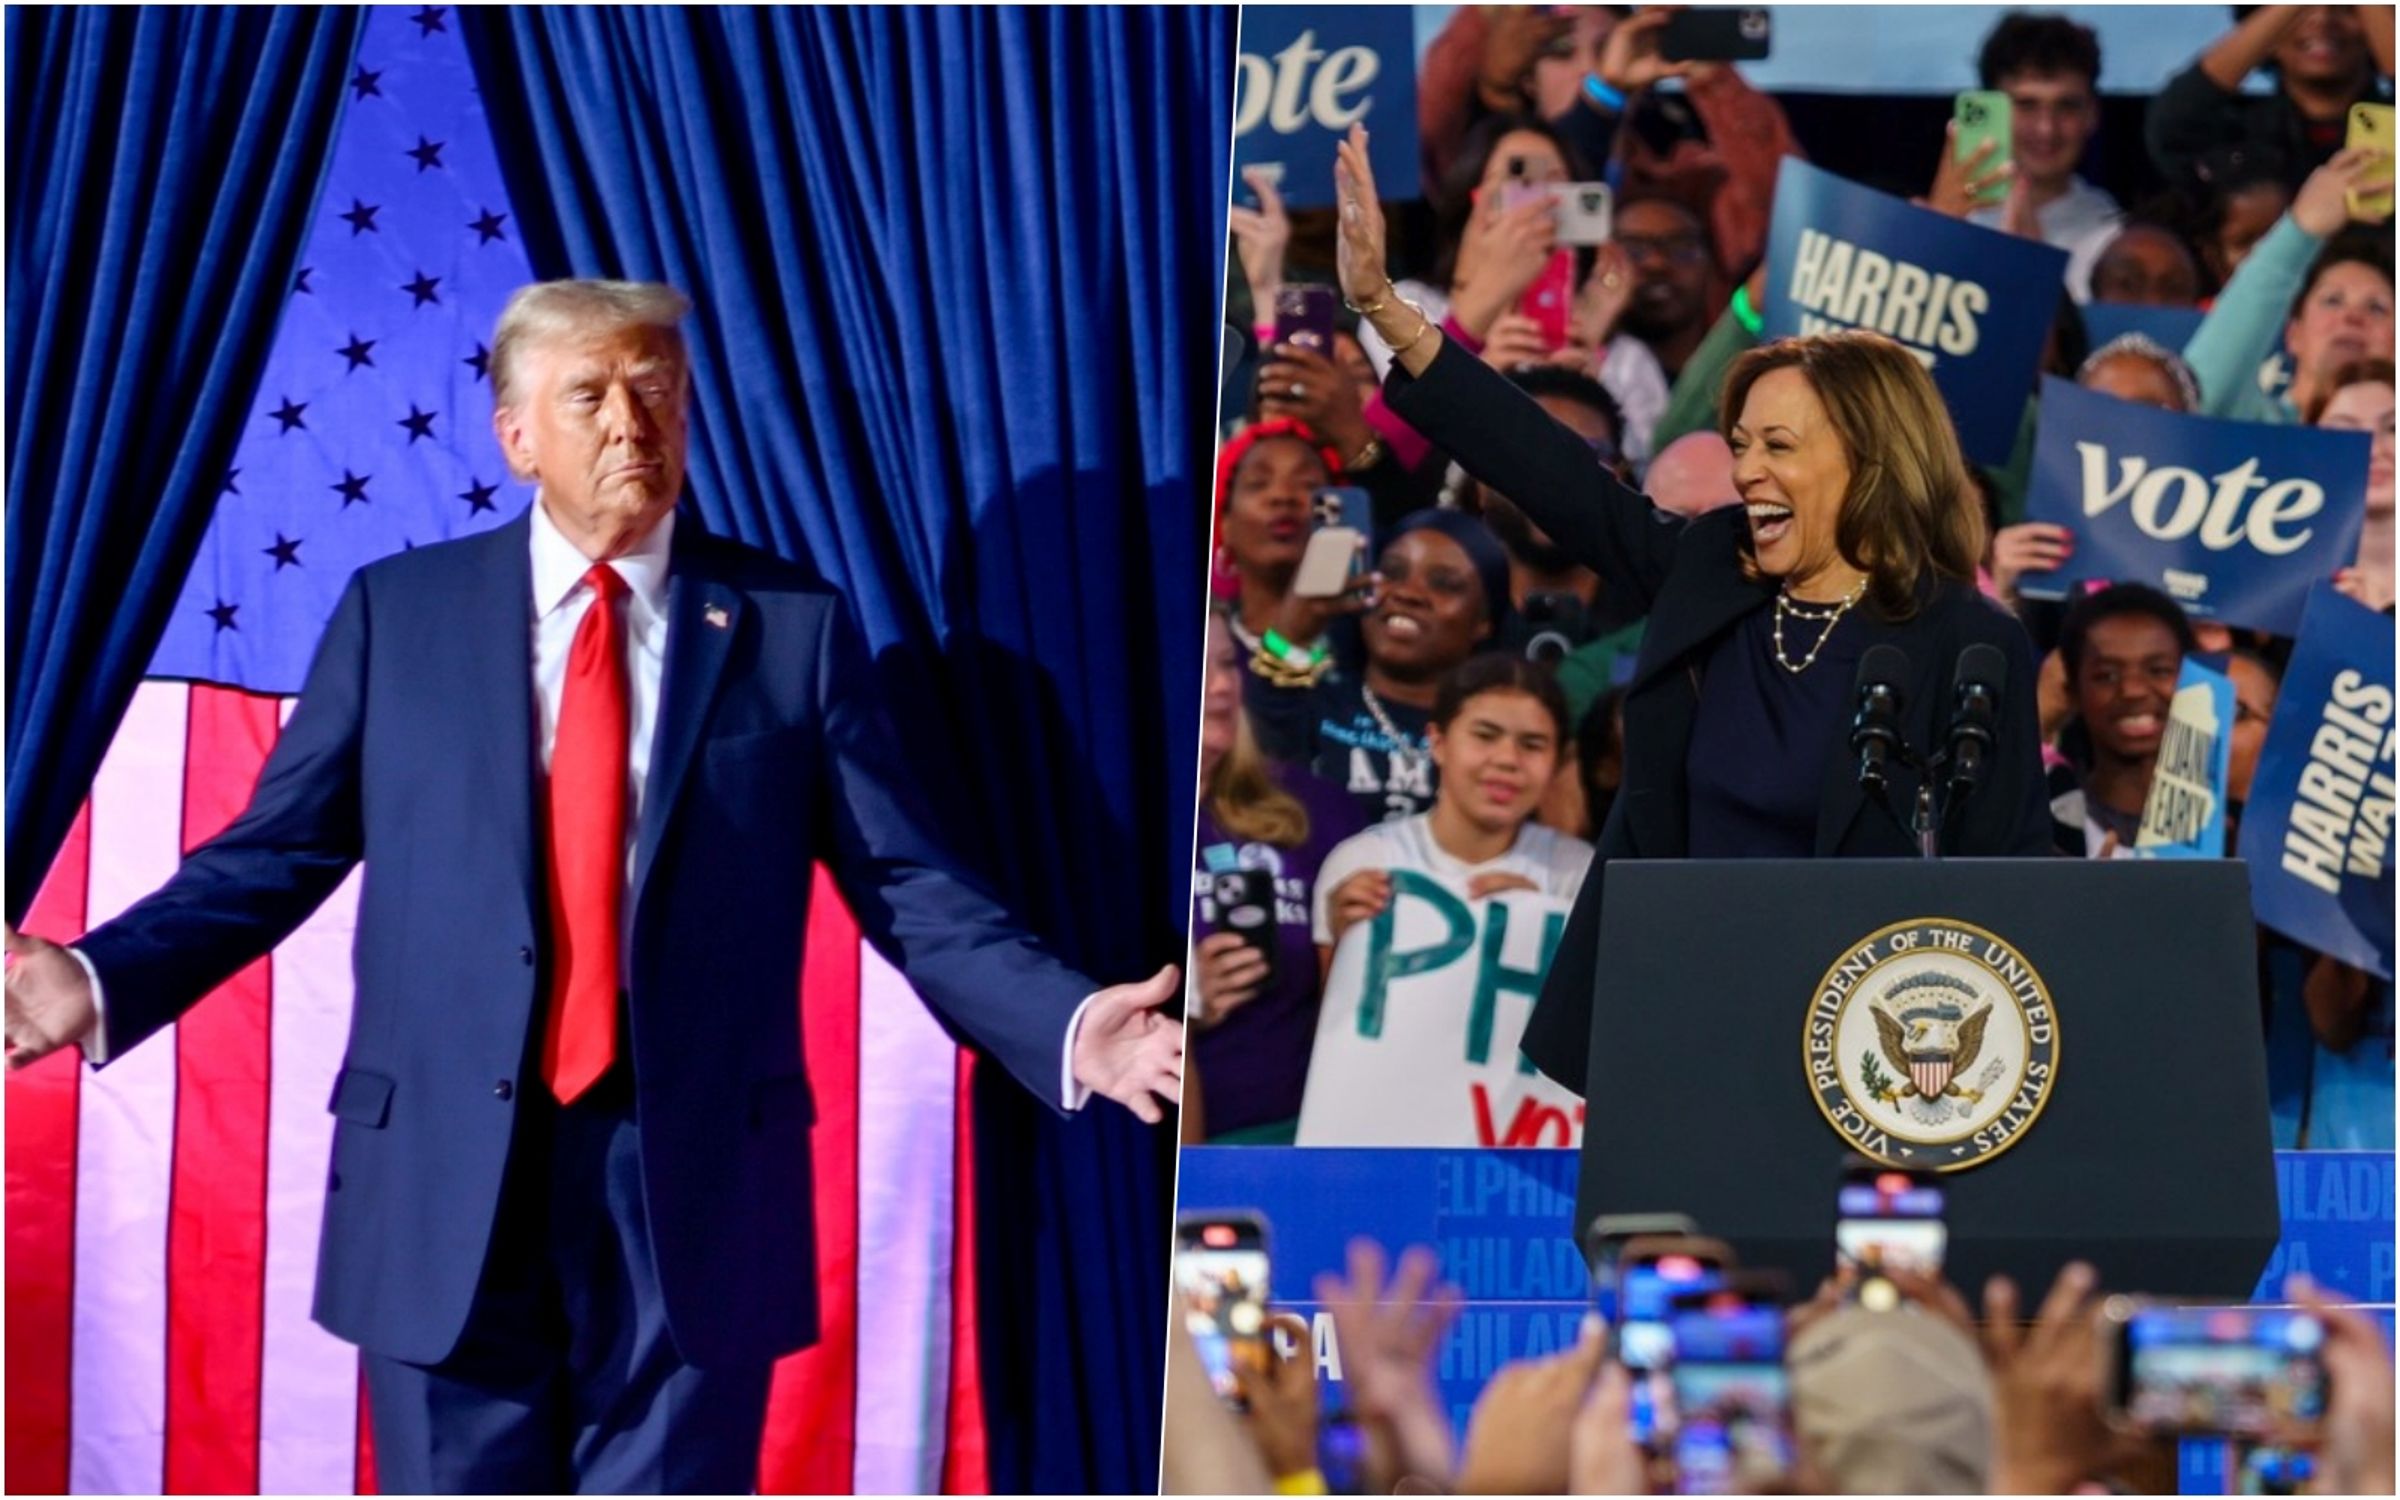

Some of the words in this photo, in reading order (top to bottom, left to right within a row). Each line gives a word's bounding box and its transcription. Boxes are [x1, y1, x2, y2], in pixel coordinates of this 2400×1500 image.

[1789, 228, 1989, 356] HARRIS
[2076, 440, 2325, 556] vote
[2281, 668, 2394, 894] HARRIS
[1890, 931, 1920, 951] OF
[1929, 929, 1974, 952] THE
[1812, 944, 1879, 1089] PRESIDENT
[1983, 943, 2051, 1044] UNITED
[1831, 1099, 1889, 1156] VICE
[1973, 1061, 2047, 1153] STATES
[1437, 1238, 1591, 1298] HILAD
